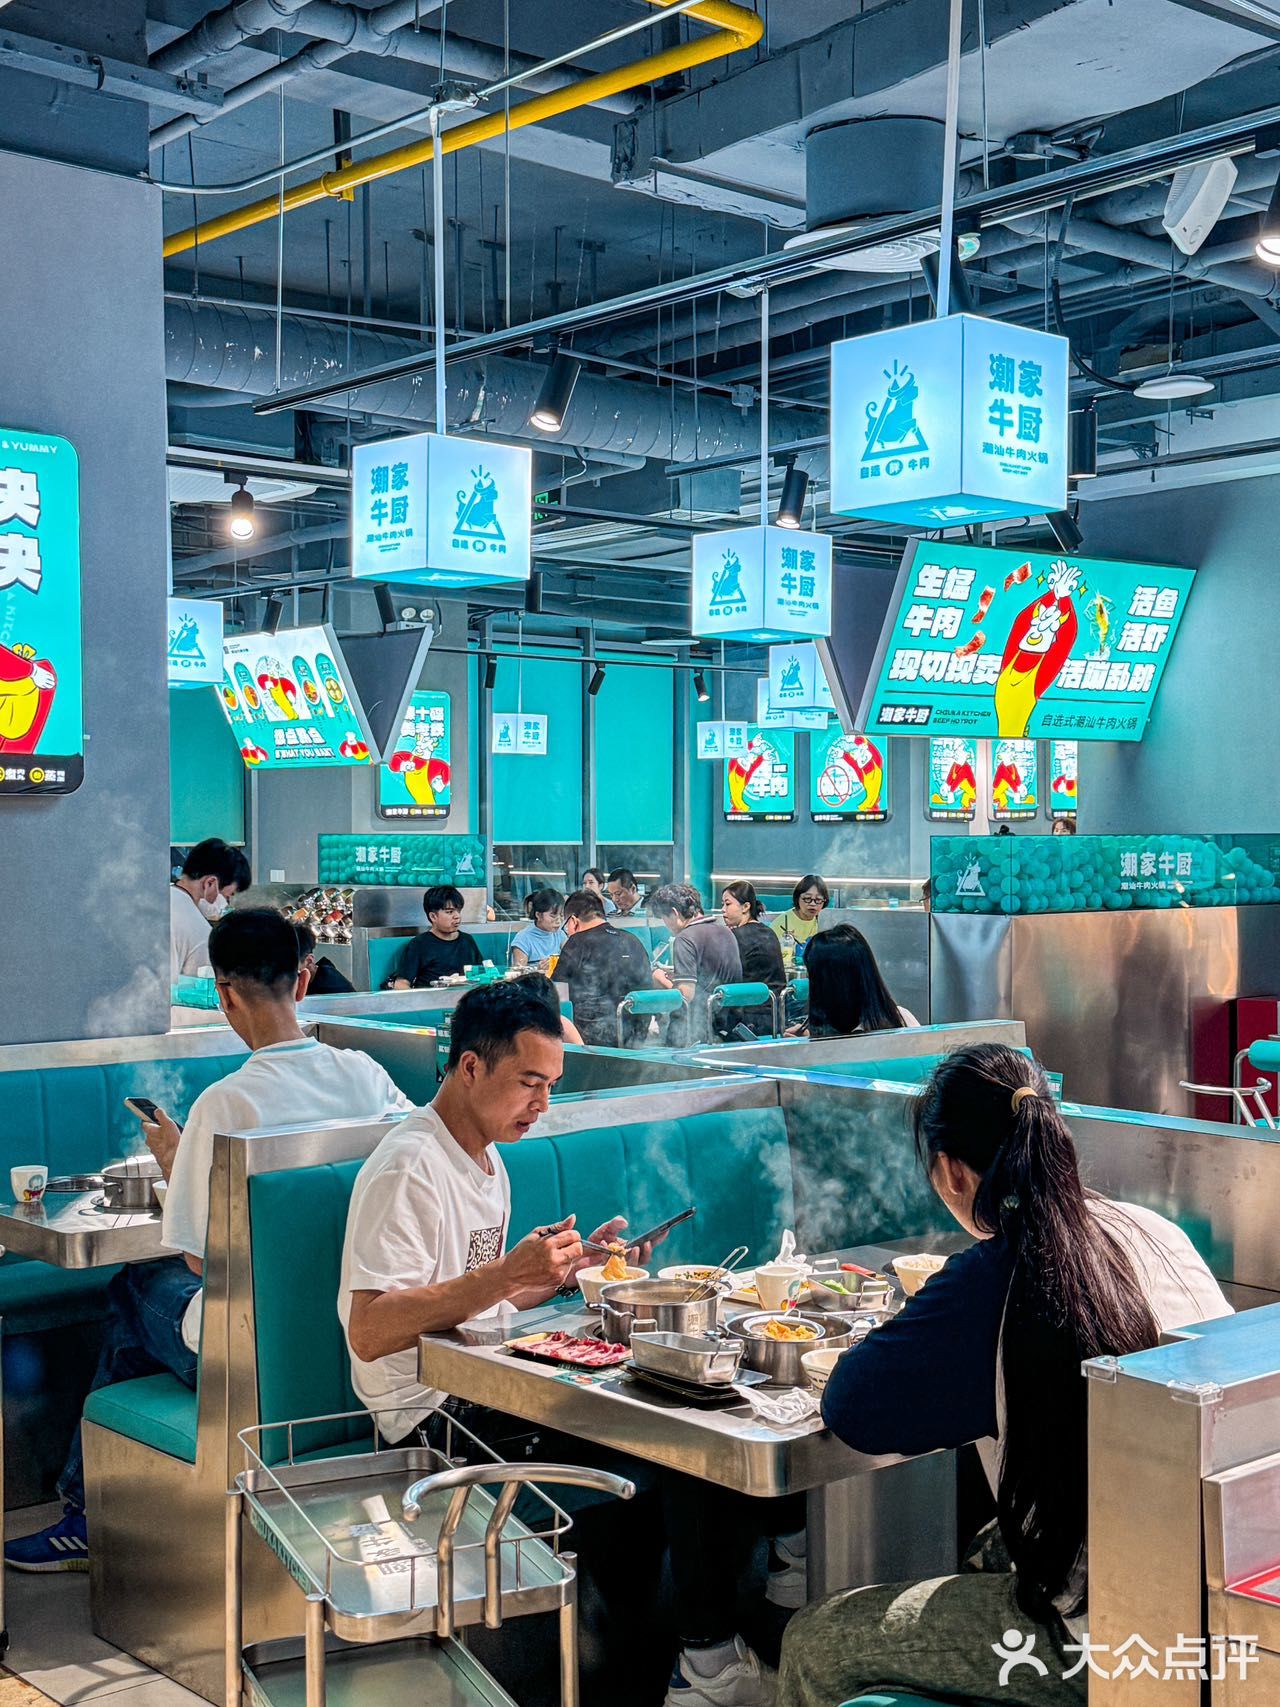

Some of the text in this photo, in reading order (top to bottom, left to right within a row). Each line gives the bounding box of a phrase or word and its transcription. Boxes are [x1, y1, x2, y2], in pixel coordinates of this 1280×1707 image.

[989, 353, 1043, 398] 潮家
[988, 398, 1043, 443] 牛厨
[11, 440, 57, 454] YUMMY
[982, 441, 1049, 465] 潮汕牛肉火锅
[370, 462, 409, 495] 潮家
[370, 495, 409, 527] 牛厨
[781, 546, 816, 572] 潮家
[781, 572, 816, 598] 牛厨
[913, 563, 977, 602] 生猛
[1127, 584, 1180, 619] 活鱼
[902, 603, 965, 640] 牛肉
[1115, 620, 1171, 653] 活虾
[888, 648, 1003, 685] 现切现卖
[1055, 658, 1157, 692] 活蹦乱跳
[879, 706, 930, 723] 潮家牛厨
[1120, 852, 1193, 877] 潮家牛厨
